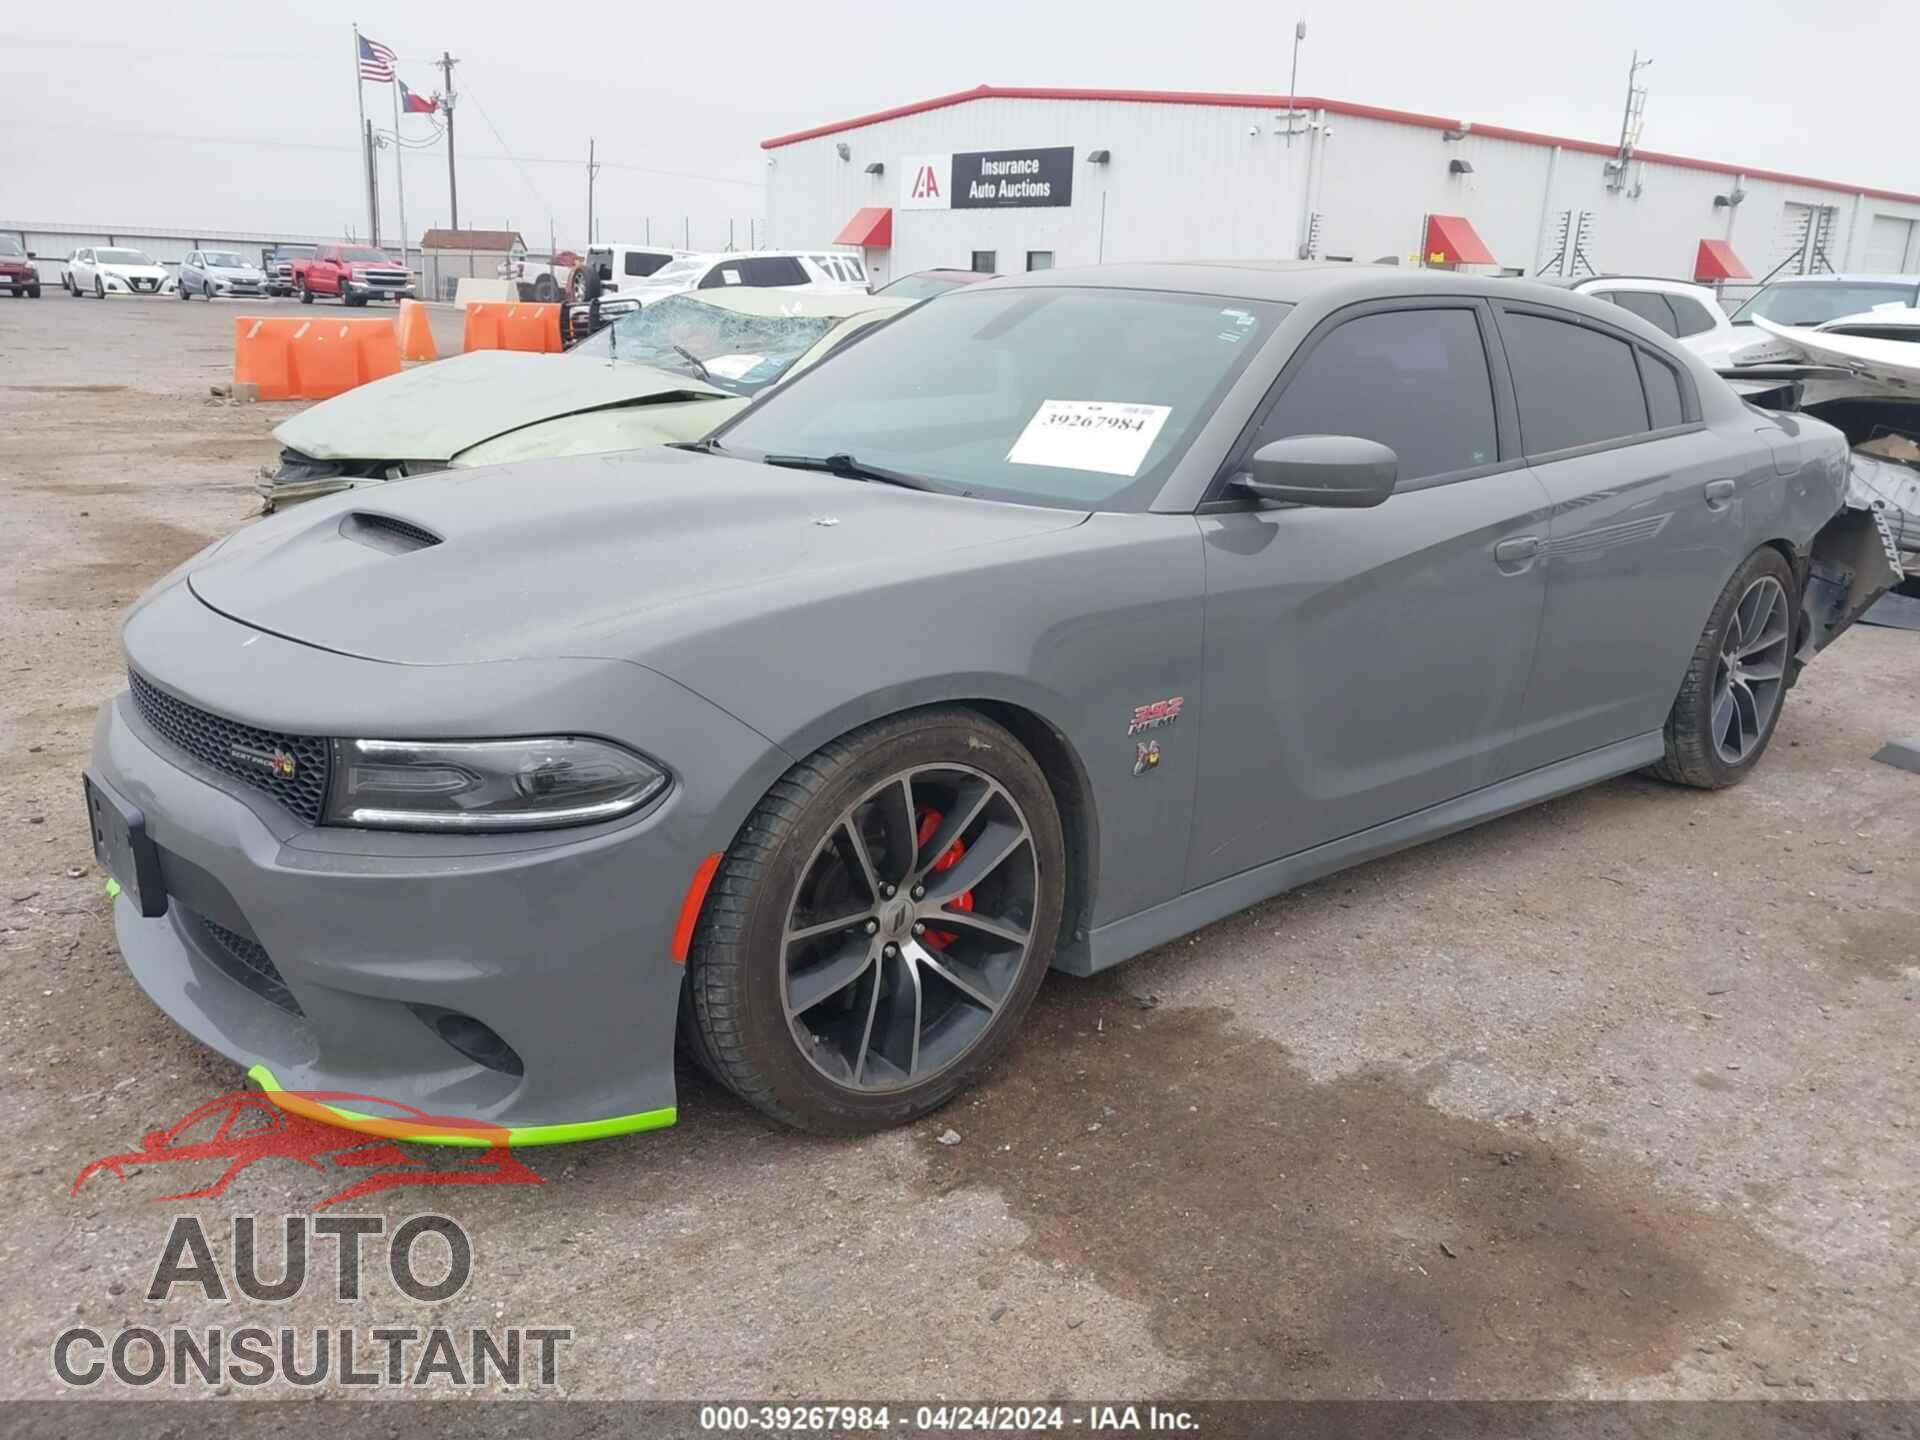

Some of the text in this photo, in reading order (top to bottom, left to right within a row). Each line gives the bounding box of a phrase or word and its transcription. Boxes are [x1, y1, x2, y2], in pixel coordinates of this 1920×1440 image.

[981, 157, 1039, 175] Insurance
[968, 178, 1051, 198] Auto Auctions
[1049, 412, 1145, 432] 39267984
